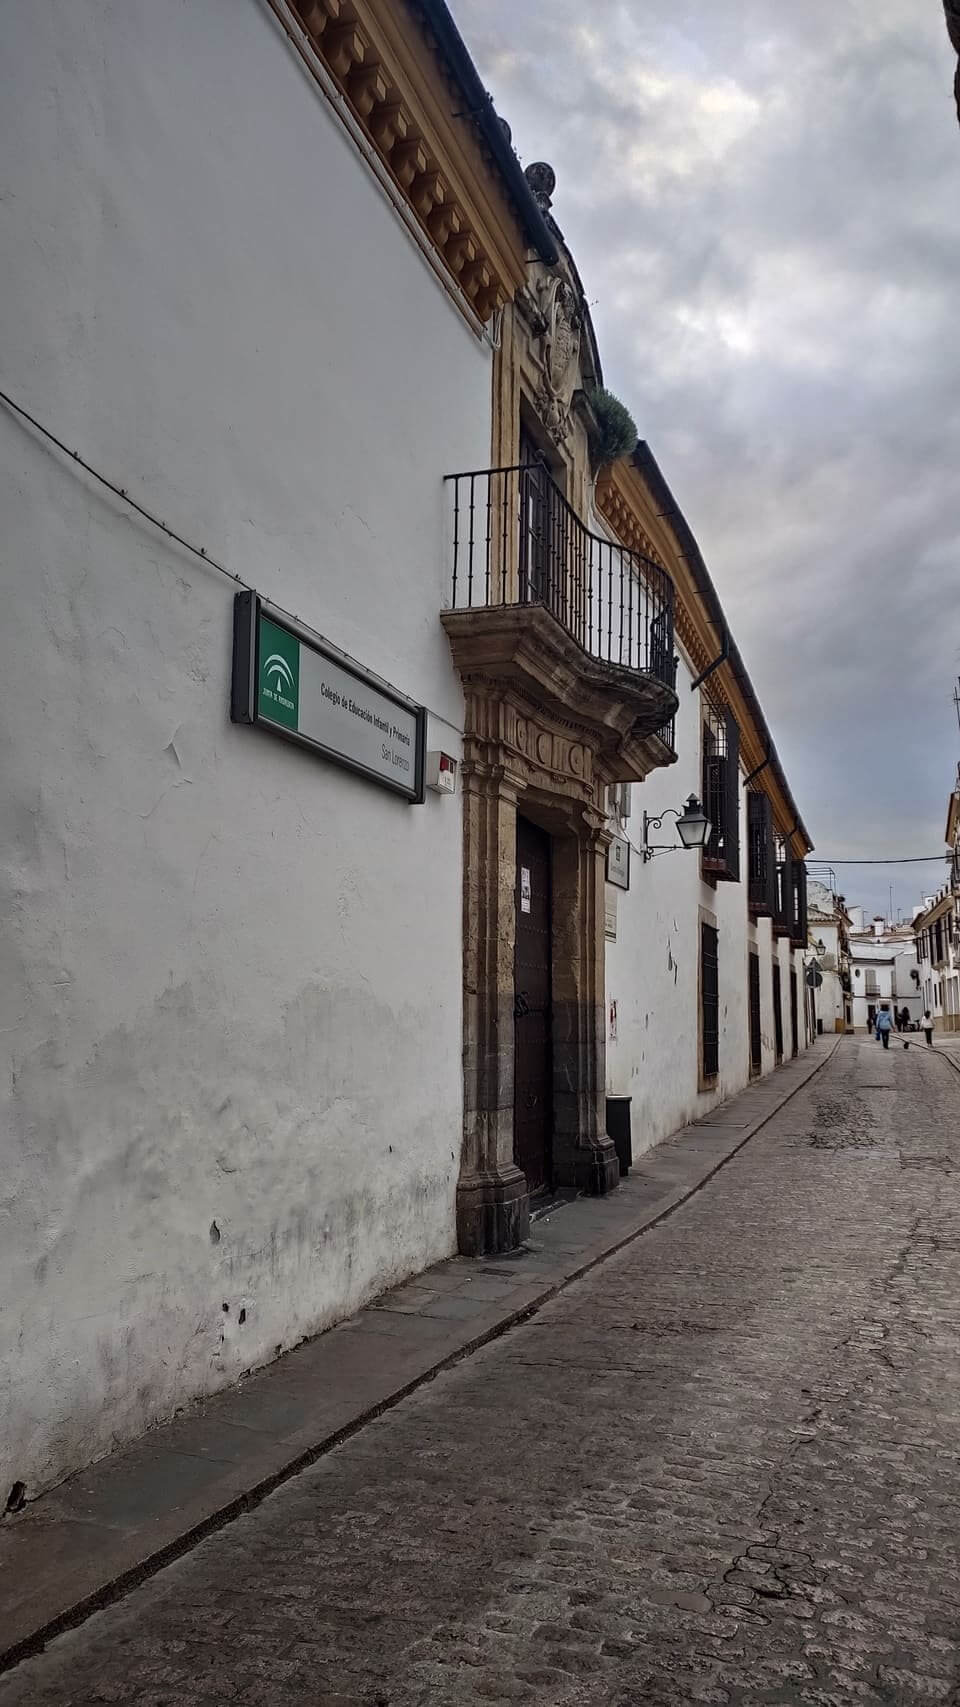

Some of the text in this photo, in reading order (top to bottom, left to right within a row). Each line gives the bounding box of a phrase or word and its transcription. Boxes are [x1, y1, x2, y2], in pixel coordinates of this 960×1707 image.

[320, 682, 341, 705] Colegio
[341, 696, 348, 709] de
[348, 699, 373, 724] Educación
[373, 714, 389, 734] Infantil
[393, 726, 410, 746] Primaria
[381, 743, 410, 772] San Lorenzo
